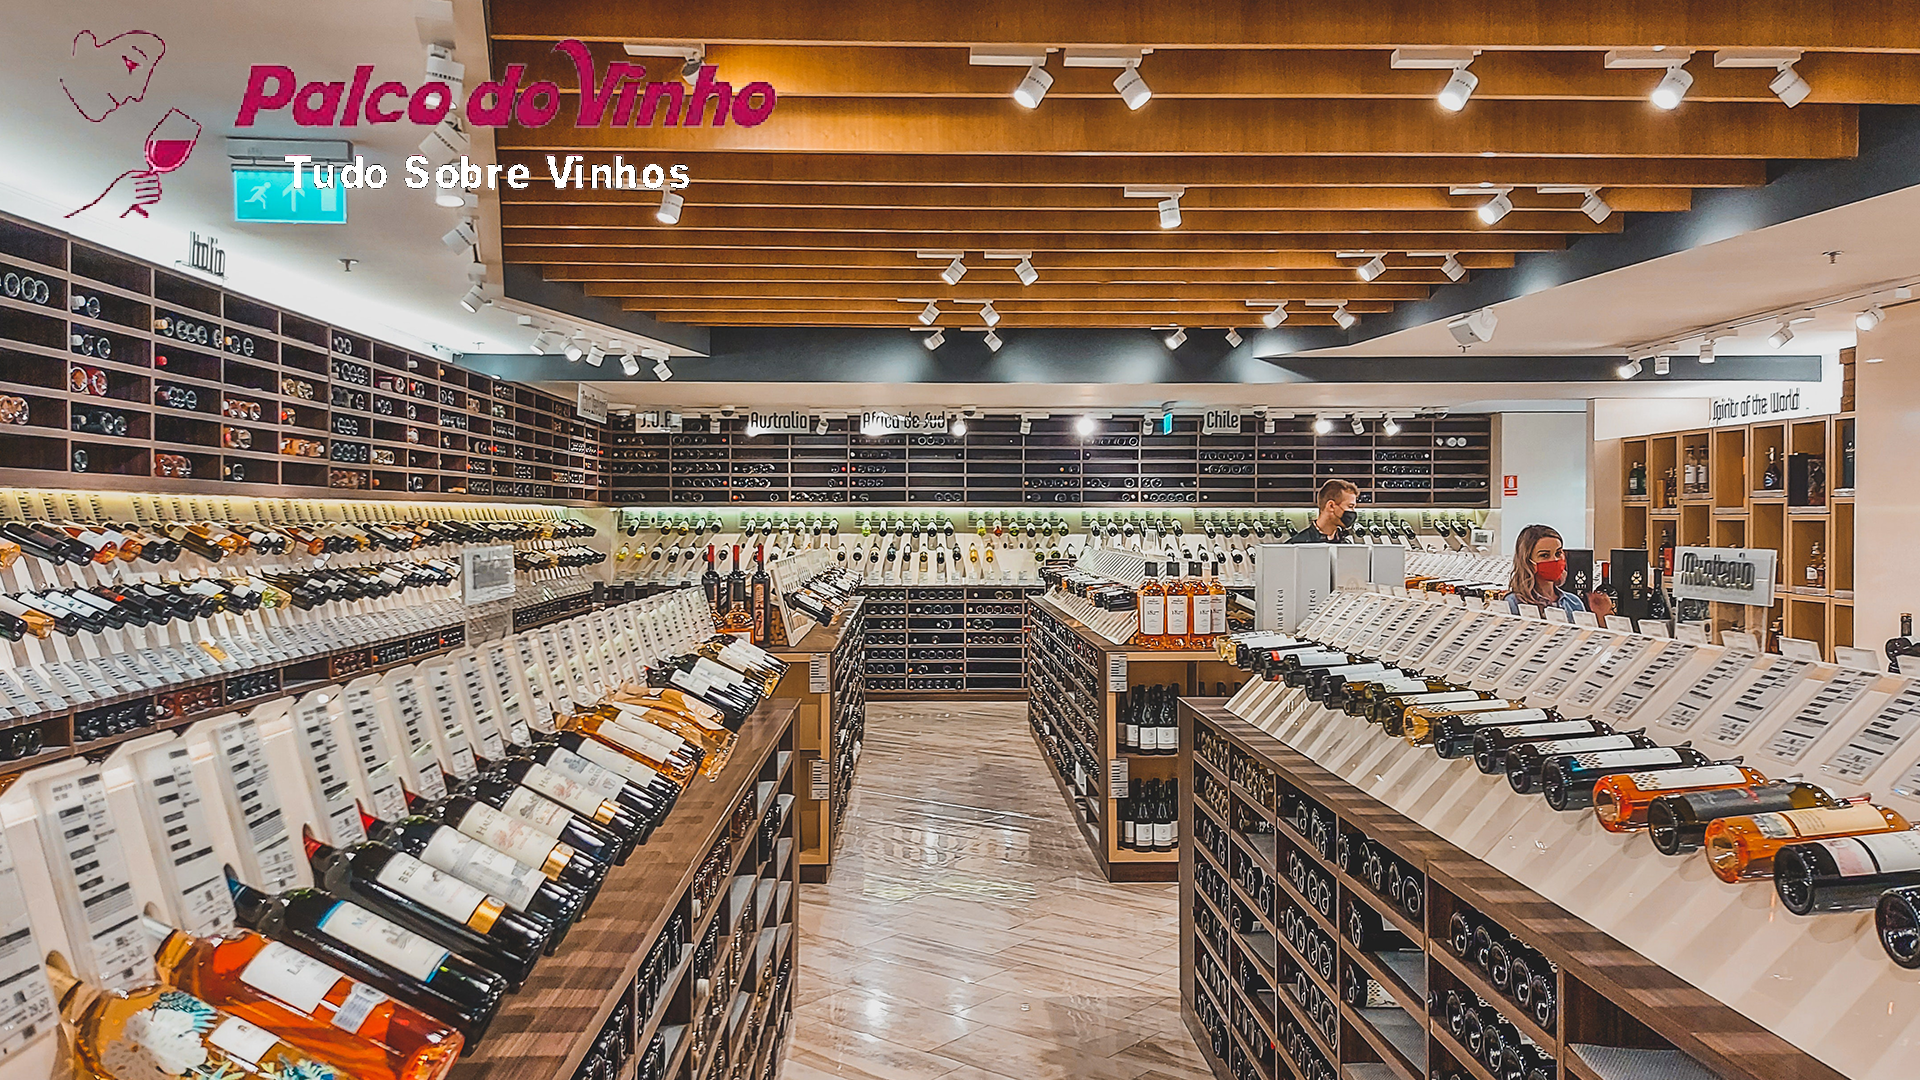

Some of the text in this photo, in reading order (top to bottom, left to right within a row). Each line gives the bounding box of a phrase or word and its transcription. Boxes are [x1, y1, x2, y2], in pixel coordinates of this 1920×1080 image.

[1740, 394, 1750, 417] of
[1752, 394, 1768, 416] the
[1770, 387, 1800, 413] World
[751, 410, 807, 429] Australia
[904, 410, 920, 429] de
[922, 411, 945, 429] Sud
[1207, 410, 1239, 428] Chile
